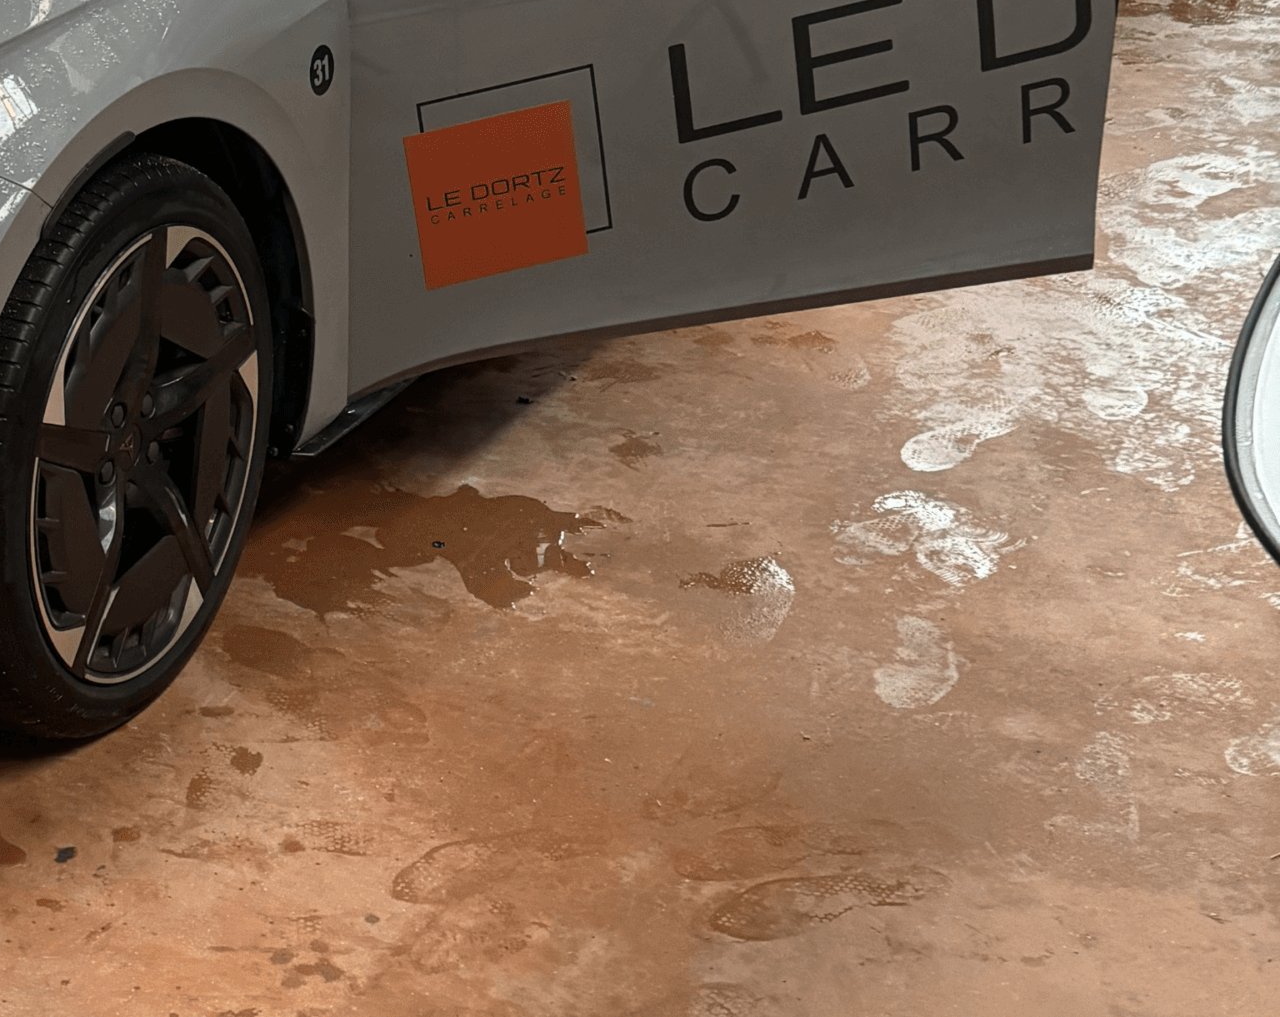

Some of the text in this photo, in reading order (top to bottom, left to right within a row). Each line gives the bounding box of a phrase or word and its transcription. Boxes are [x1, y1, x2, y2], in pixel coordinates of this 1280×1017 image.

[313, 54, 331, 87] 31
[683, 77, 1077, 222] CARR
[426, 166, 567, 212] LE DORTZ
[430, 185, 566, 225] CARRELAGE
